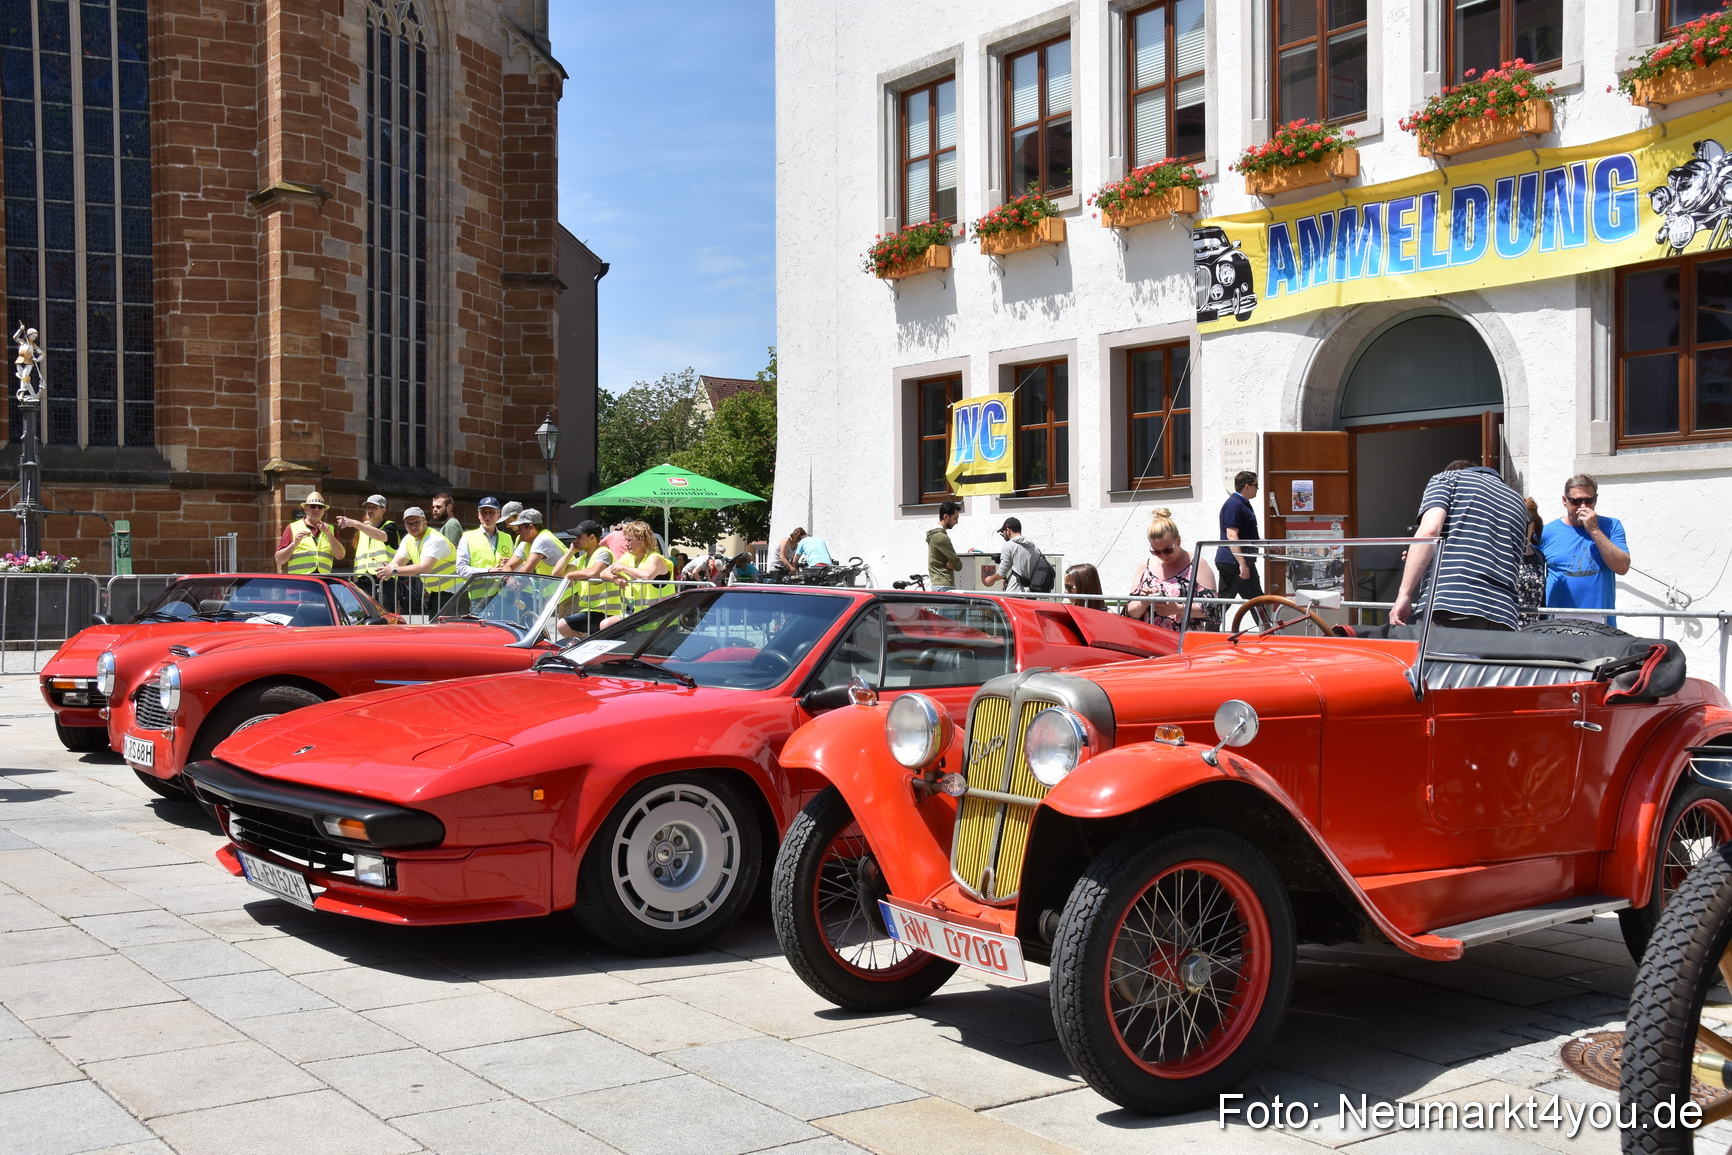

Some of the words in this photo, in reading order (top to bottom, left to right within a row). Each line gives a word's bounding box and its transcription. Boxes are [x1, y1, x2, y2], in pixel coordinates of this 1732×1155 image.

[1265, 152, 1641, 300] ANMELDUNG
[953, 399, 1008, 466] WC
[899, 912, 935, 950] NM
[943, 927, 1008, 971] 0700
